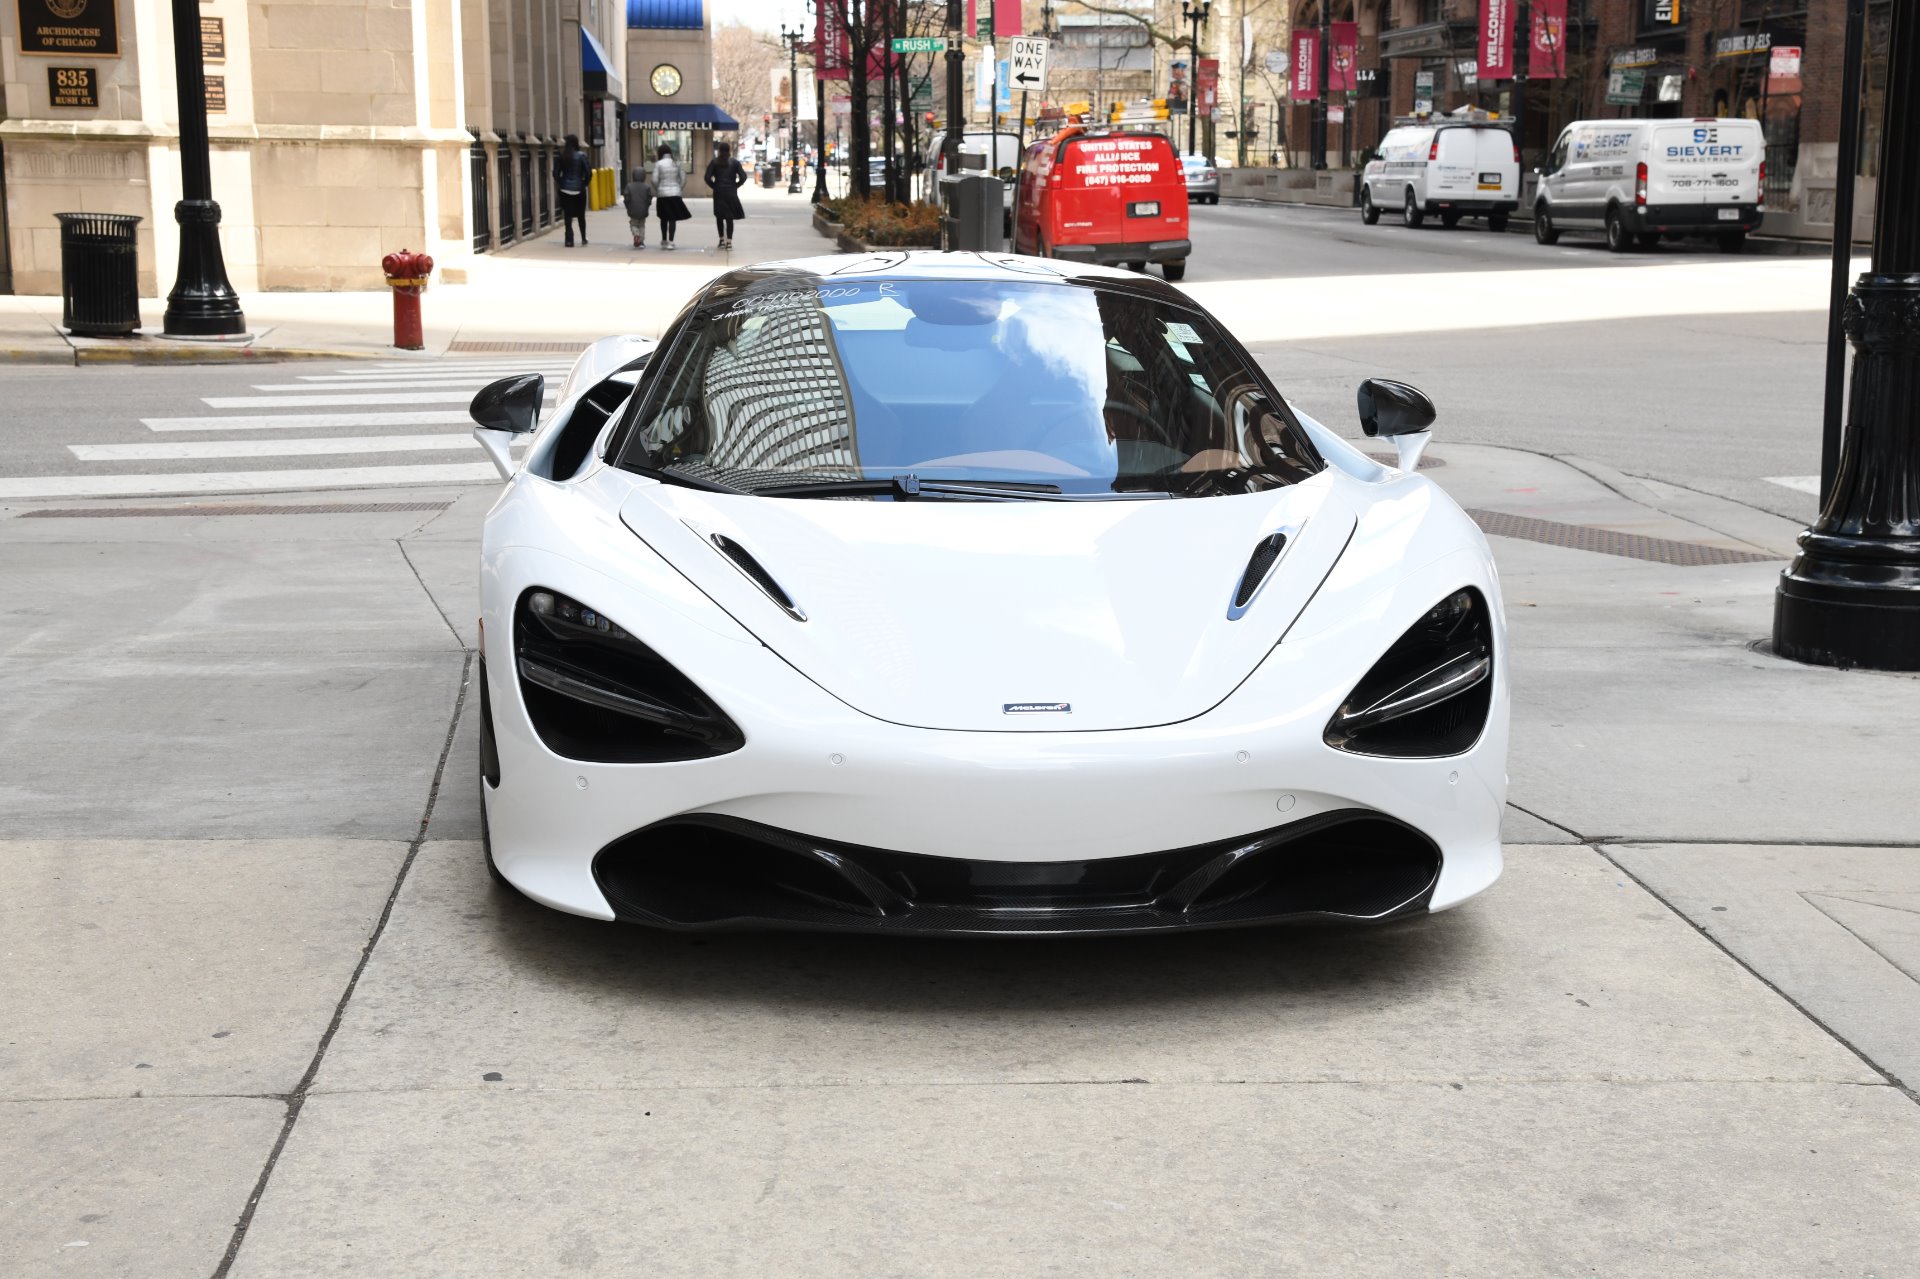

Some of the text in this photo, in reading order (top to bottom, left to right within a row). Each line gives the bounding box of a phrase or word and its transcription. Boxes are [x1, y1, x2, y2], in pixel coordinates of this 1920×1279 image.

[37, 26, 101, 37] ARCHDIOCESE
[42, 37, 96, 47] OF CHICAGO
[902, 40, 931, 51] RUSH
[1015, 41, 1043, 56] ONE
[1014, 56, 1043, 69] WAY
[1298, 38, 1308, 91] WELCOME
[57, 70, 88, 86] 835
[59, 88, 88, 96] NORTH
[55, 96, 78, 104] RUSH
[630, 121, 712, 130] GHIRARDELLI
[1080, 141, 1152, 152] UNITED STATES
[1667, 145, 1743, 156] SIEVERT
[1076, 163, 1159, 174] FIRE PROTECTION
[880, 283, 896, 294] R
